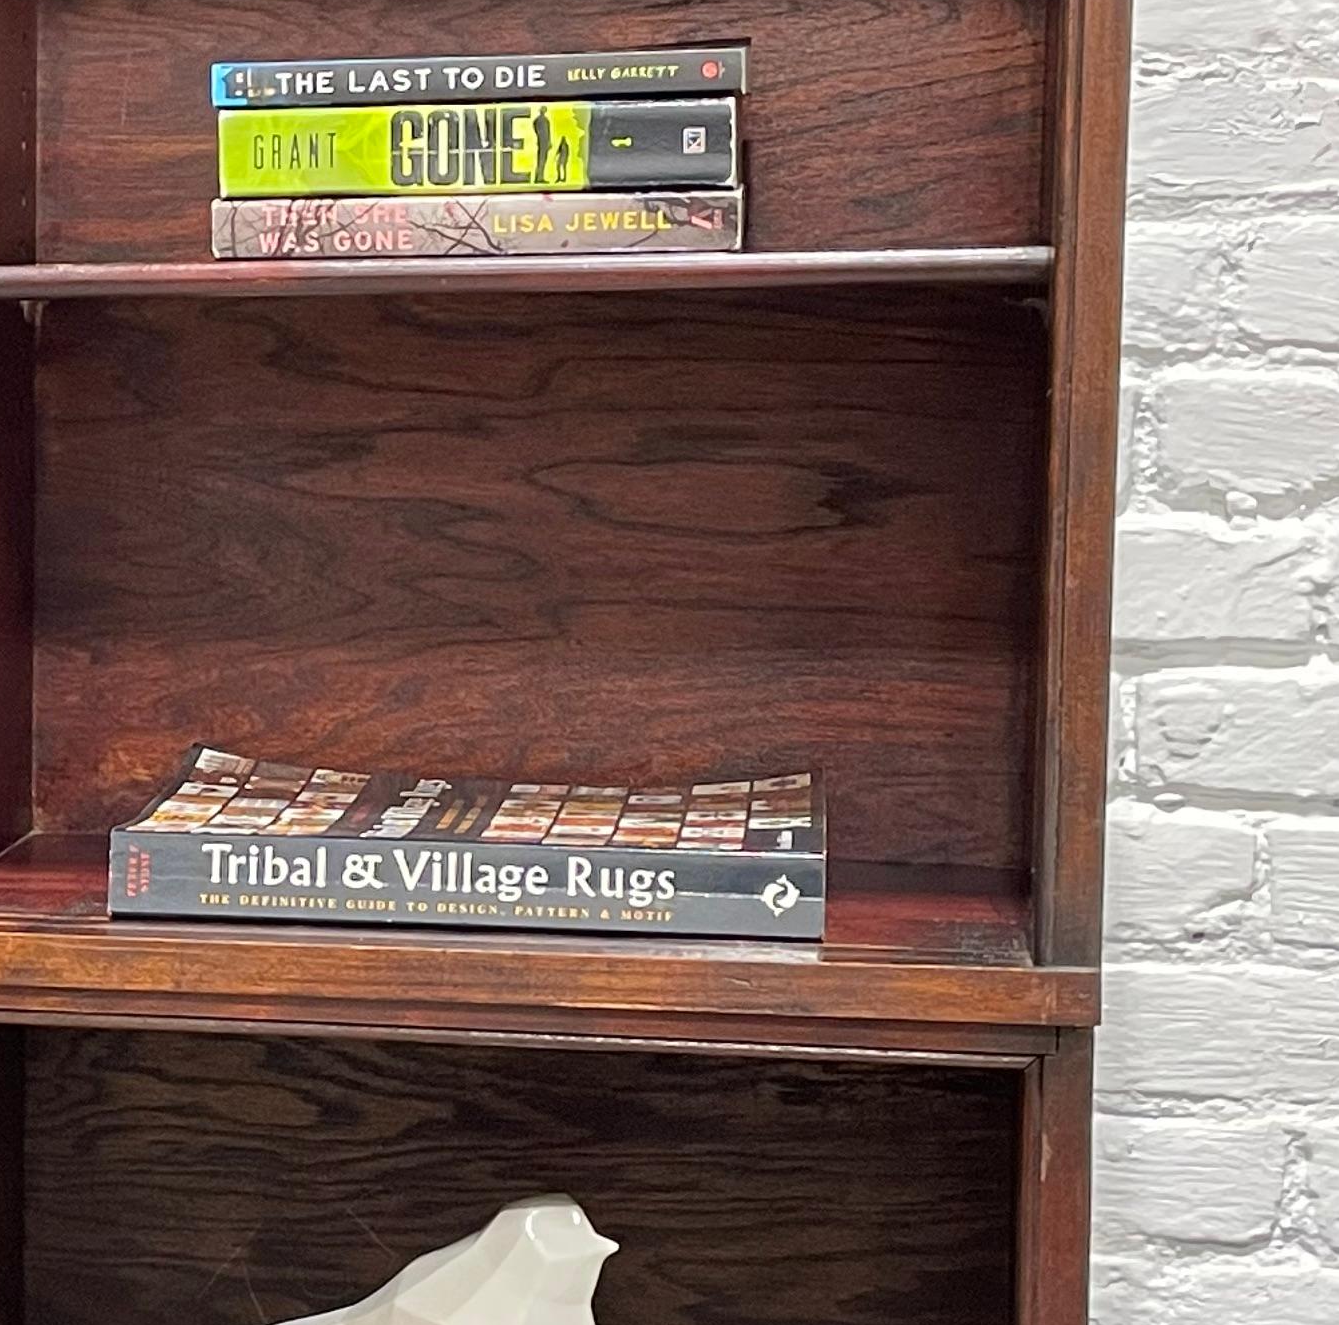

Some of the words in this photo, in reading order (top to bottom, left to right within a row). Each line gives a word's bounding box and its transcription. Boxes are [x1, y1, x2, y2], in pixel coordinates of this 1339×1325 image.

[275, 71, 336, 95] THE
[348, 68, 433, 94] LAST
[443, 66, 486, 90] TO
[495, 65, 547, 89] DIE
[253, 132, 338, 170] GRANT
[390, 107, 532, 187] GONE
[493, 214, 554, 234] LISA
[565, 210, 672, 232] JEWELL
[259, 231, 320, 254] WAS
[334, 229, 413, 252] GONE
[202, 842, 328, 888] Tribal
[341, 854, 385, 890] &
[392, 849, 550, 903] Village
[567, 855, 676, 908] Rugs
[199, 893, 231, 906] THE
[239, 895, 338, 910] DEFINITIVE
[346, 898, 397, 912] GUIDE
[407, 901, 429, 913] TO
[514, 904, 591, 920] PATTERN
[620, 909, 675, 923] MOTIF
